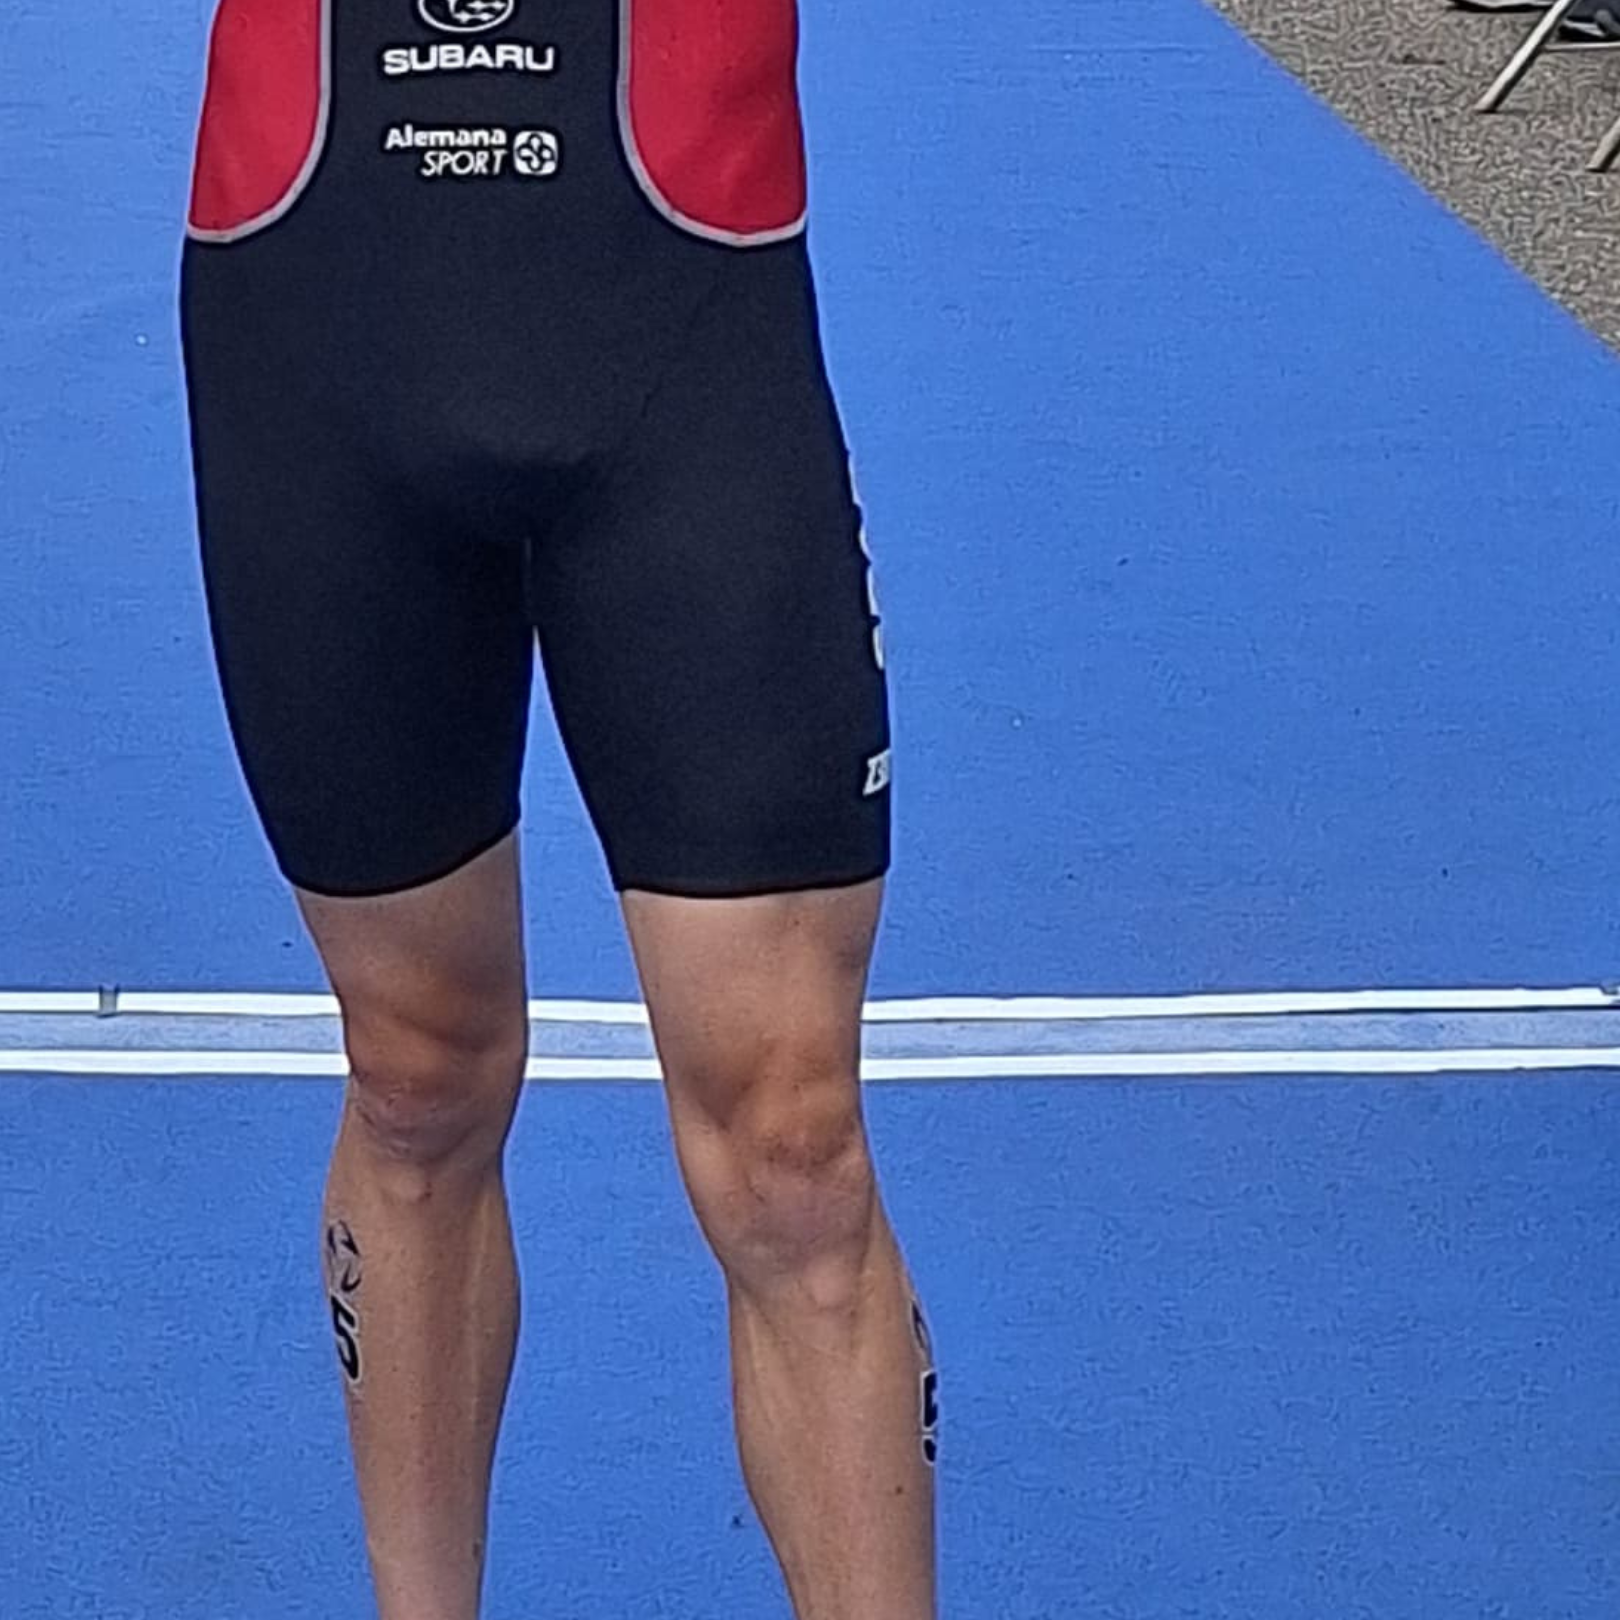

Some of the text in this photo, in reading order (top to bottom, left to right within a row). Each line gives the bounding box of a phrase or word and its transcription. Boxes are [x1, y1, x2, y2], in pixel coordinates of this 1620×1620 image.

[383, 44, 555, 75] SUBARU
[385, 124, 507, 150] Alemana
[421, 150, 508, 177] SPORT
